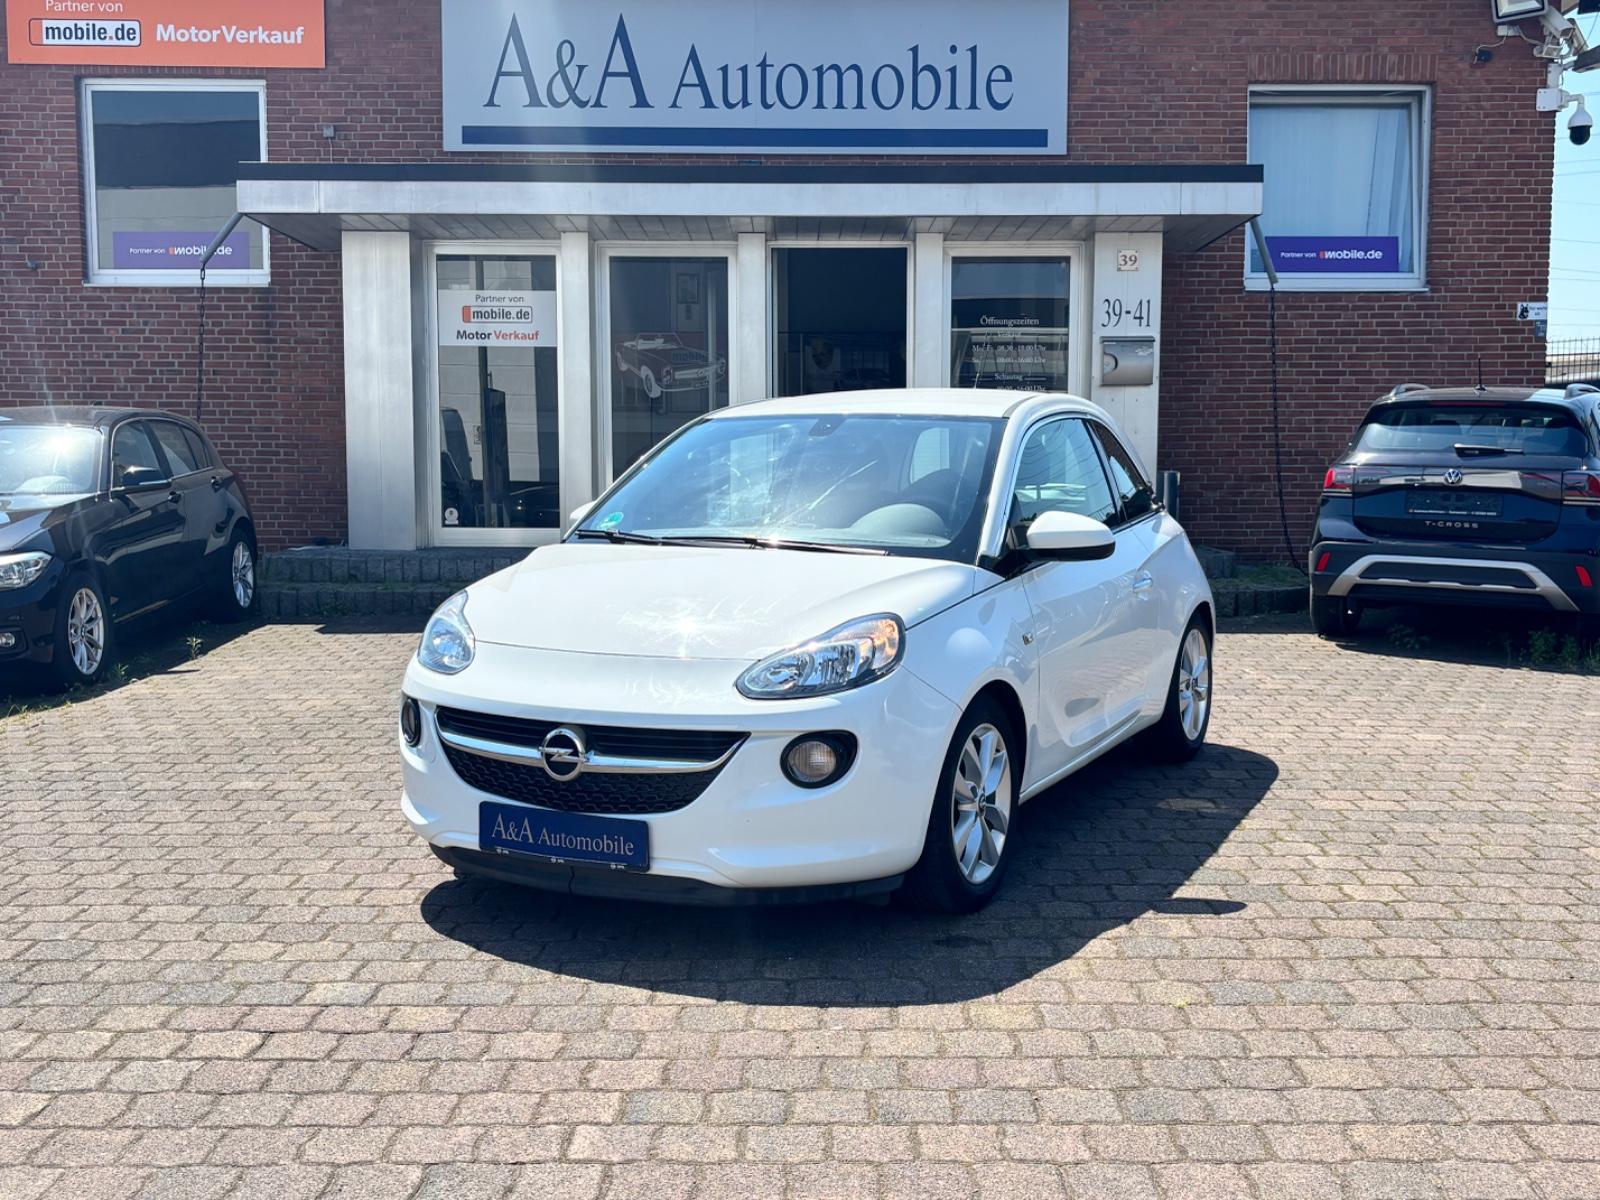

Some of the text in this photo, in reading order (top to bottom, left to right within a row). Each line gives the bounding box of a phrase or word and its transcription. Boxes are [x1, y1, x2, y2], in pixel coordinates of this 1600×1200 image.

[45, 0, 123, 12] Partner von
[45, 23, 137, 41] mobile.de
[482, 12, 1014, 111] A&A Automobile
[174, 245, 232, 255] mobil.de
[1325, 250, 1382, 259] mobile.de
[1119, 254, 1138, 267] 39
[475, 294, 524, 303] Partner von
[472, 307, 530, 320] mobile.de
[980, 315, 1040, 327] Öffnungszeiten
[492, 813, 635, 855] A&A Automobile
